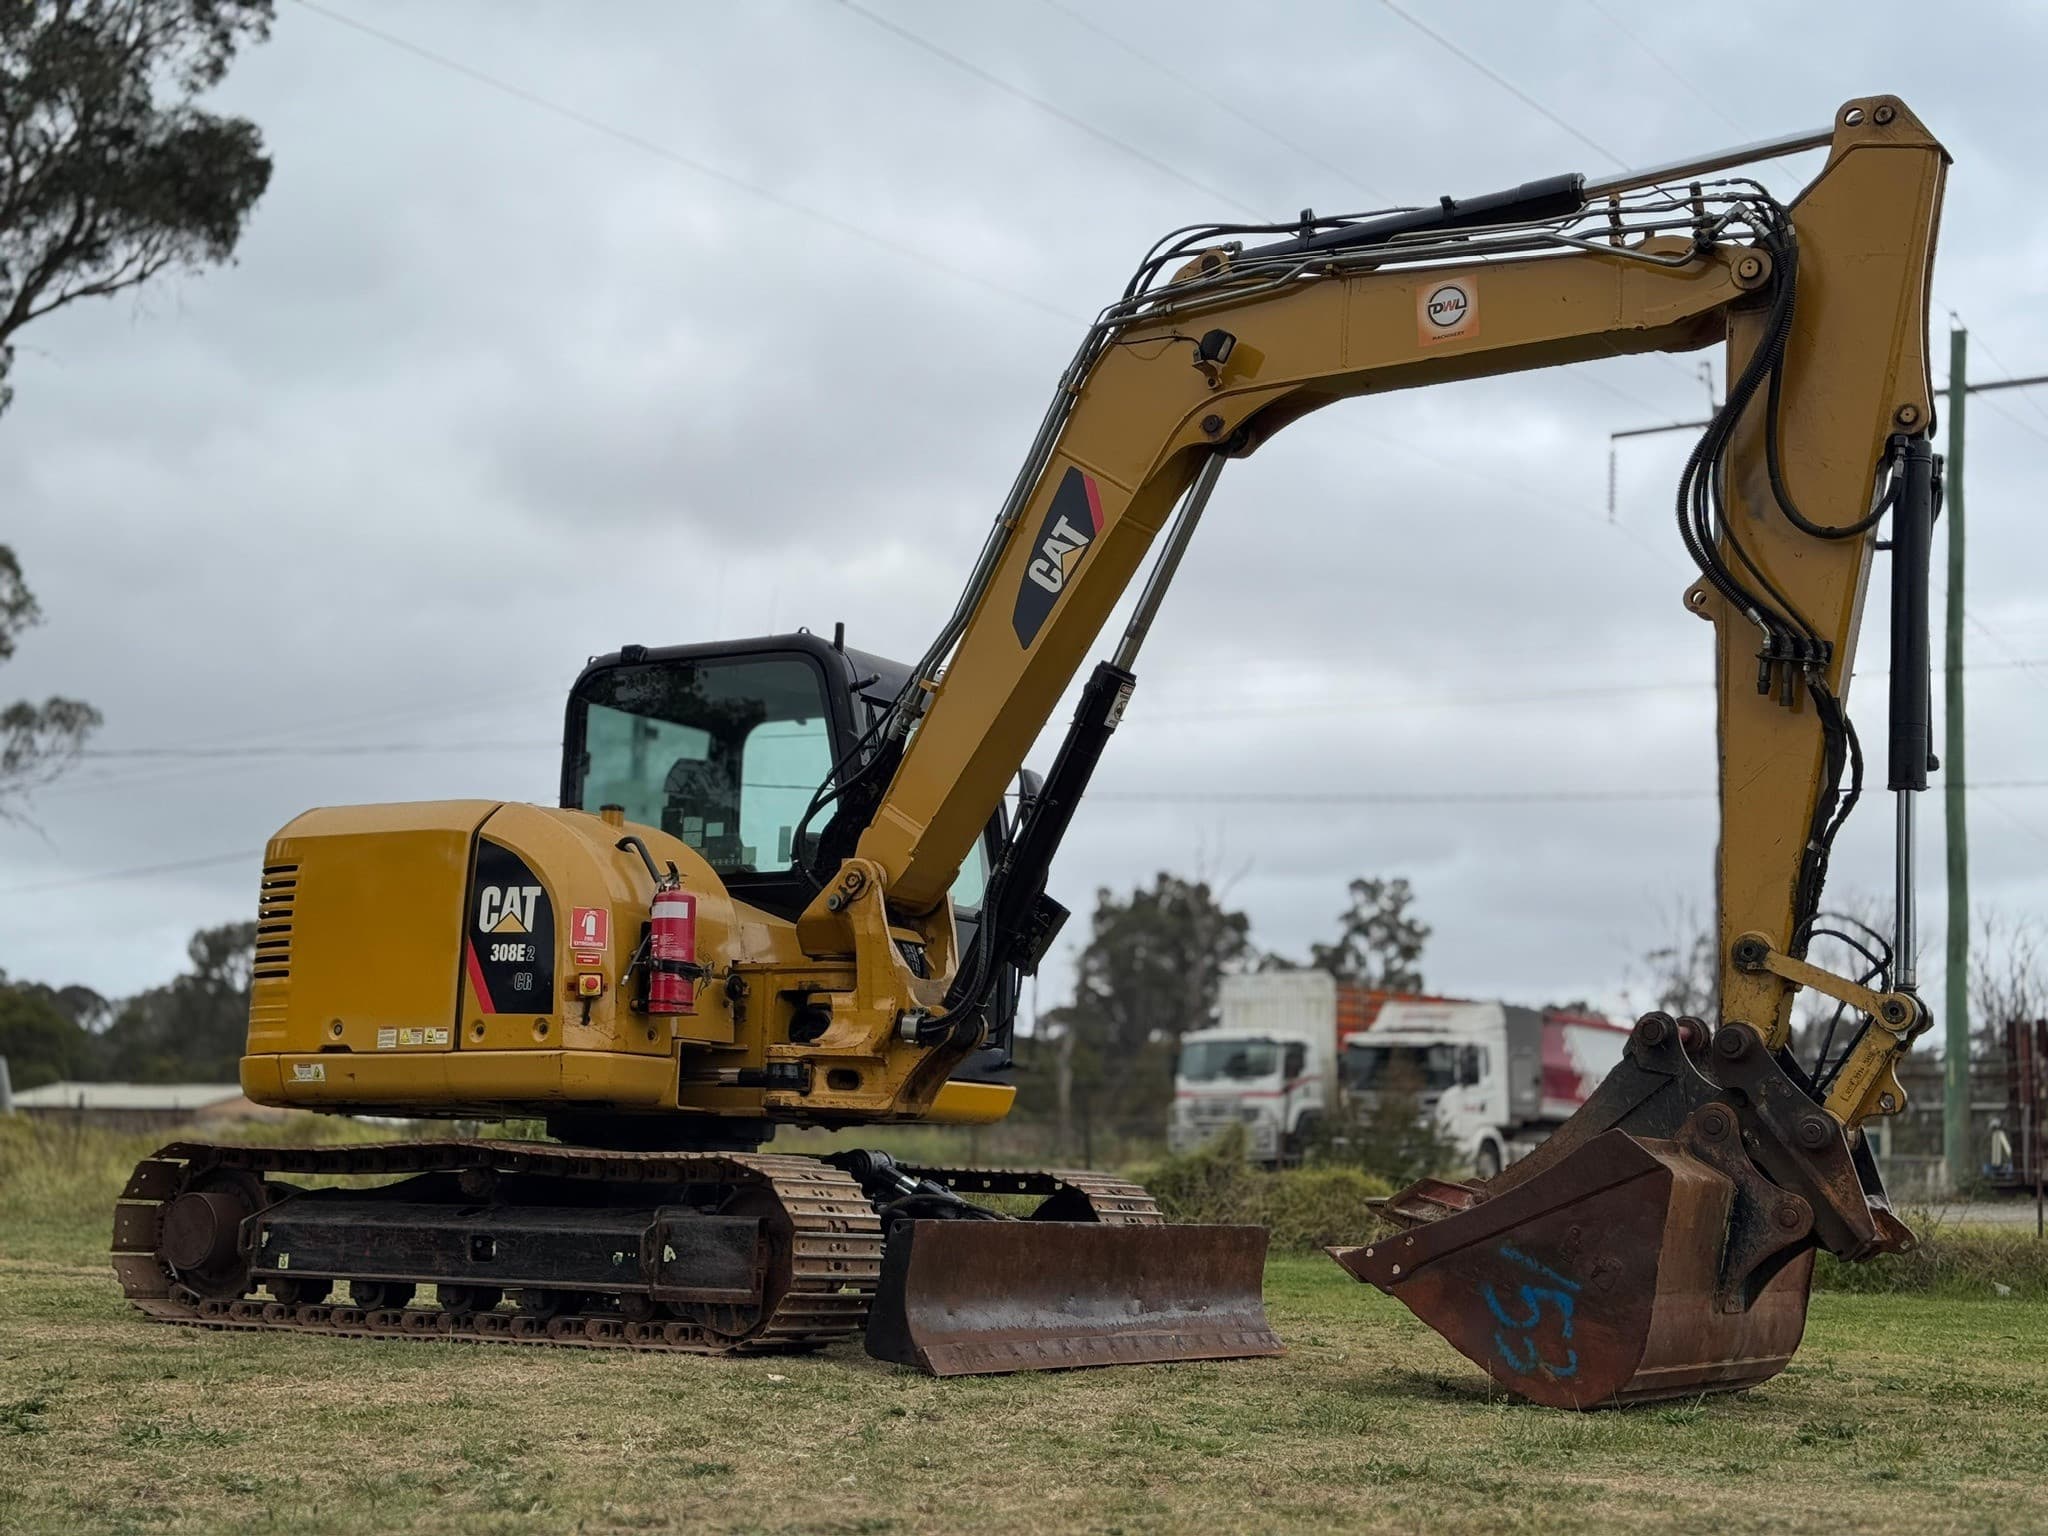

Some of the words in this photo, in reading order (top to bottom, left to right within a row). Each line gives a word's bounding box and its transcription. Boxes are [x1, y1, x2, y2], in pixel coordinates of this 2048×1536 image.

[1429, 297, 1467, 315] DWL
[1028, 514, 1090, 594] CAT
[478, 885, 542, 934] CAT
[514, 972, 533, 991] CR
